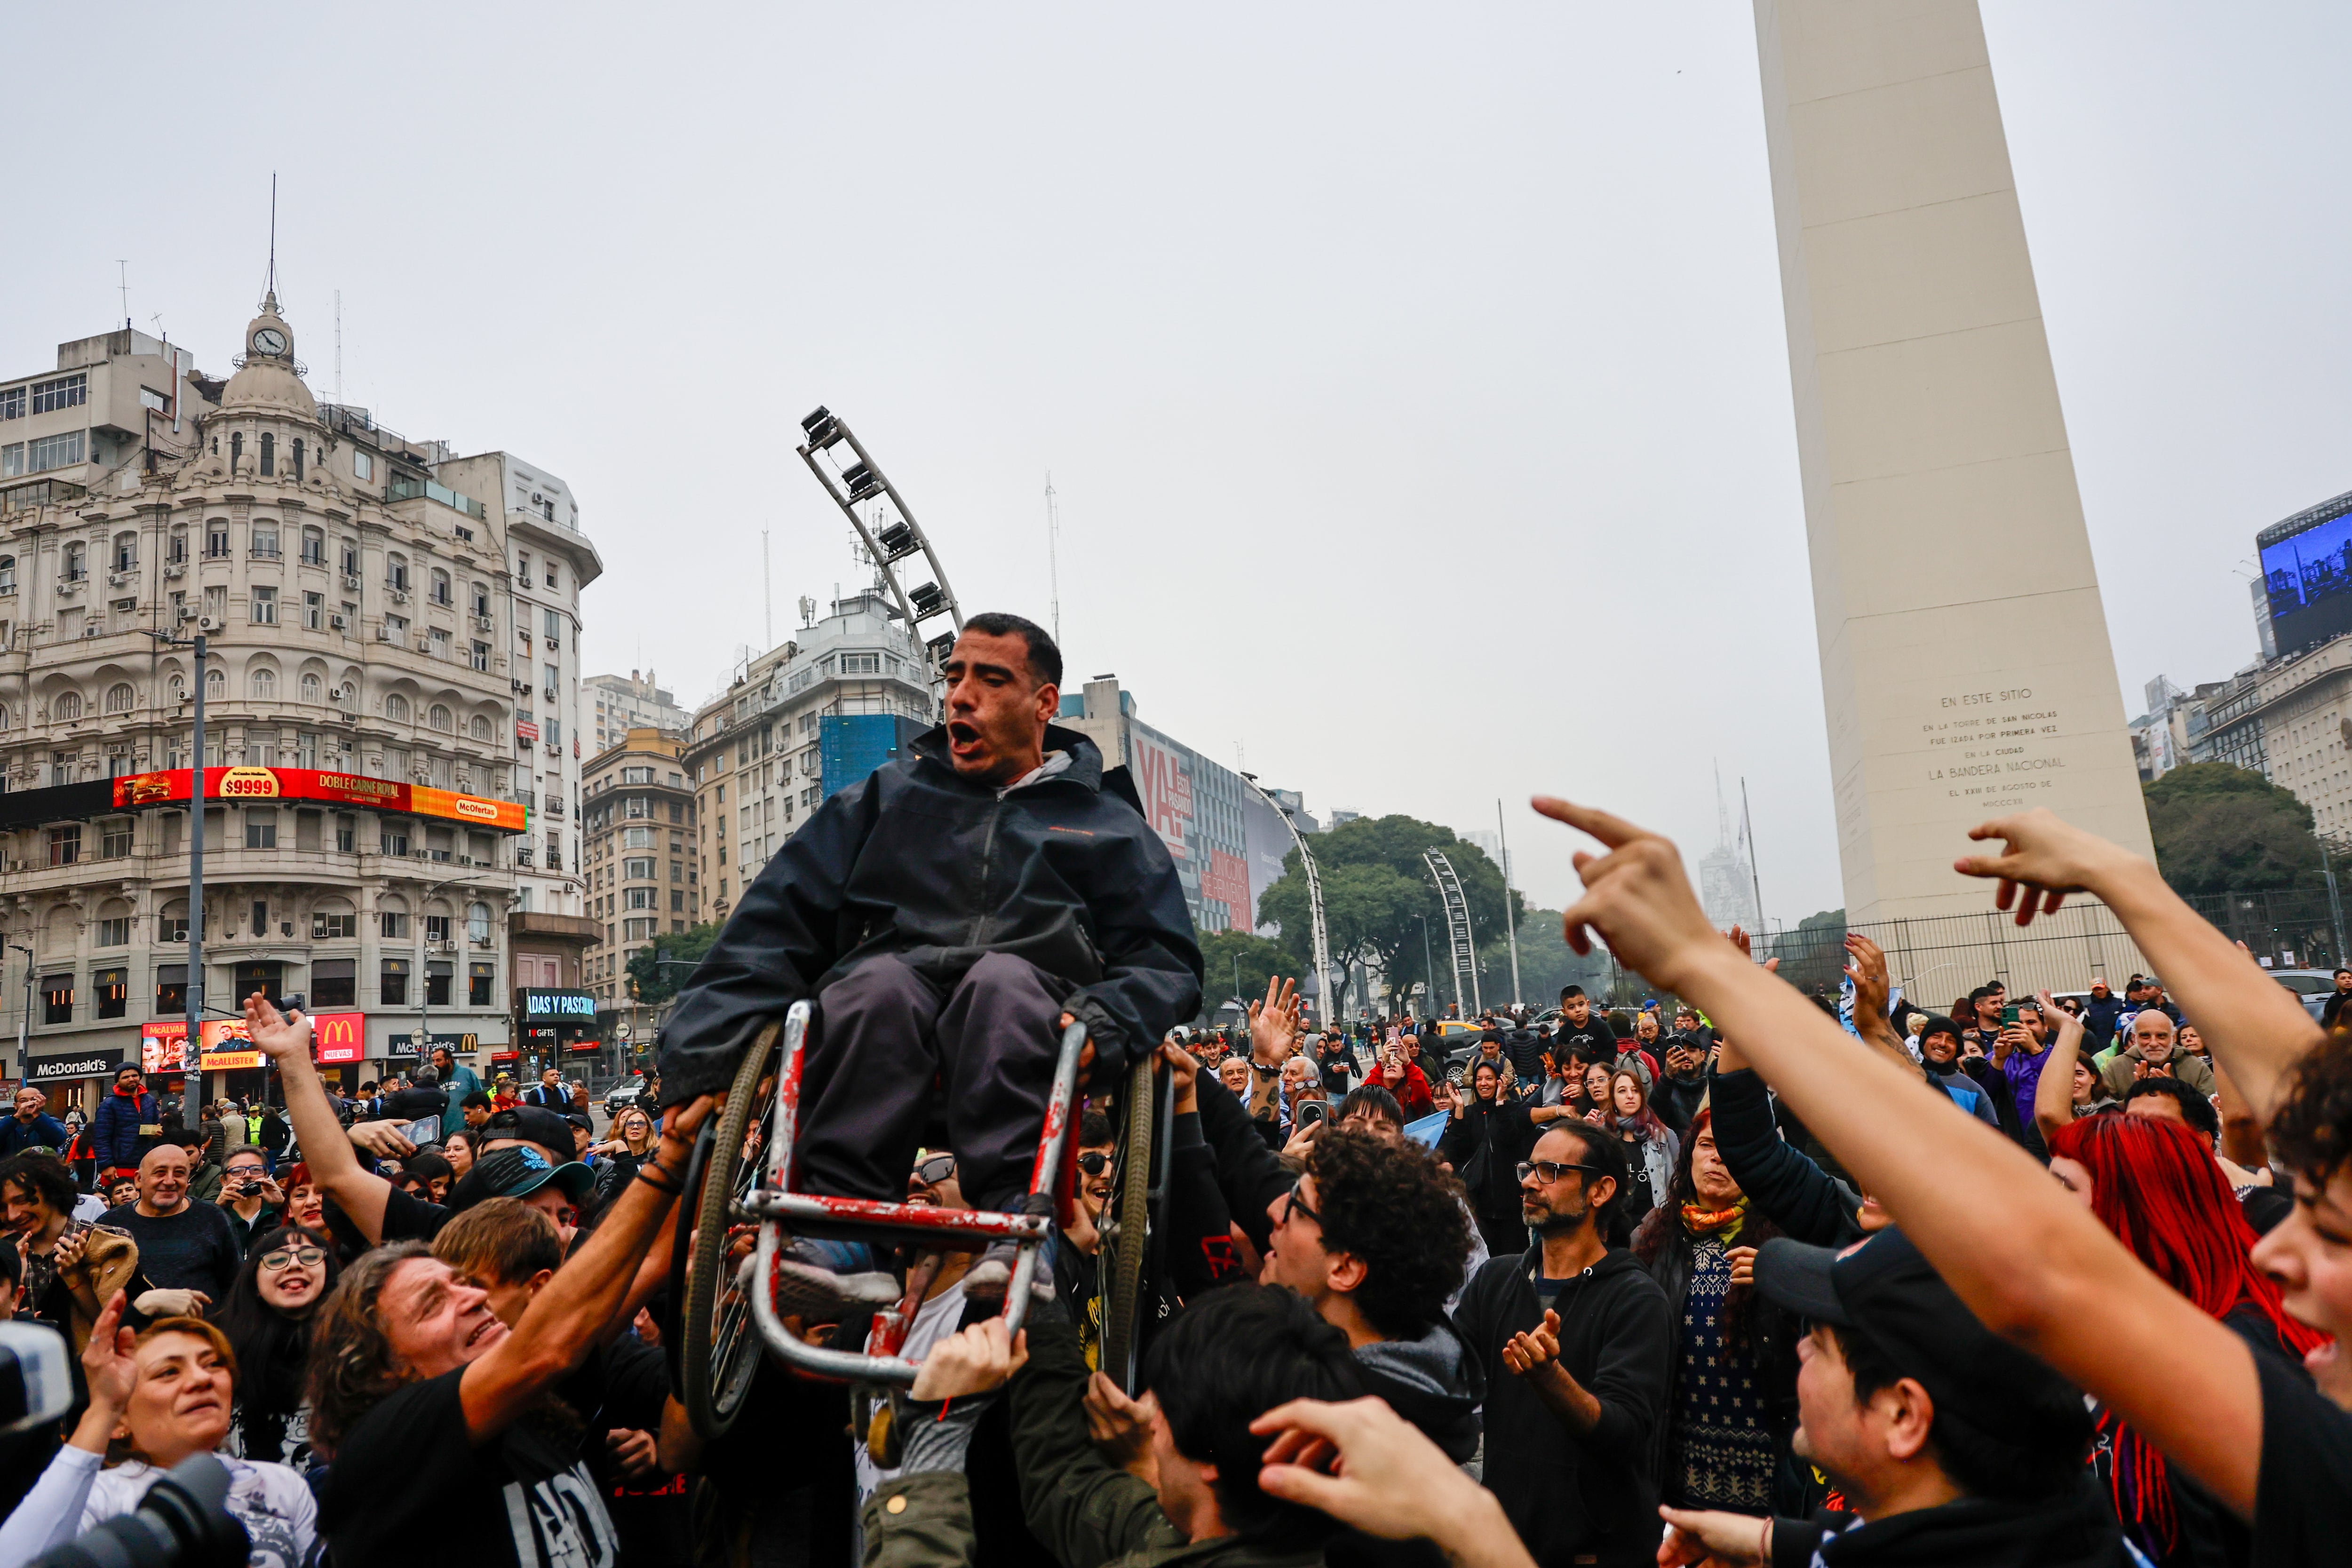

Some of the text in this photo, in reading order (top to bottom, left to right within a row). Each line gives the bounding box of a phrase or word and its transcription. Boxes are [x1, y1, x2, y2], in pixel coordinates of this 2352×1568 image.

[1942, 688, 2032, 708] EN ESTE SITIO
[1954, 719, 1980, 728] TORRE
[2022, 711, 2058, 720] NICOLAS
[1951, 735, 1974, 743] IZADA
[2001, 727, 2035, 737] PRIMERA
[1995, 747, 2024, 756] CIUDAD
[1929, 757, 2066, 780] LA BANDERA NACIONAL
[226, 780, 272, 794] $9999
[319, 775, 399, 797] DOBLE CARNE ROYAL
[1177, 774, 1191, 796] ESTÁ
[2002, 782, 2036, 791] AGOSTO
[459, 802, 494, 815] McOfertas
[1168, 790, 1192, 815] PASANDO
[1202, 874, 1247, 904] SE REINVENTA
[552, 996, 560, 1014] Y
[149, 1025, 186, 1035] McALVAR
[396, 1041, 455, 1053] Mcnald's
[37, 1059, 106, 1076] McDonald's
[207, 1057, 254, 1067] McALLISTER
